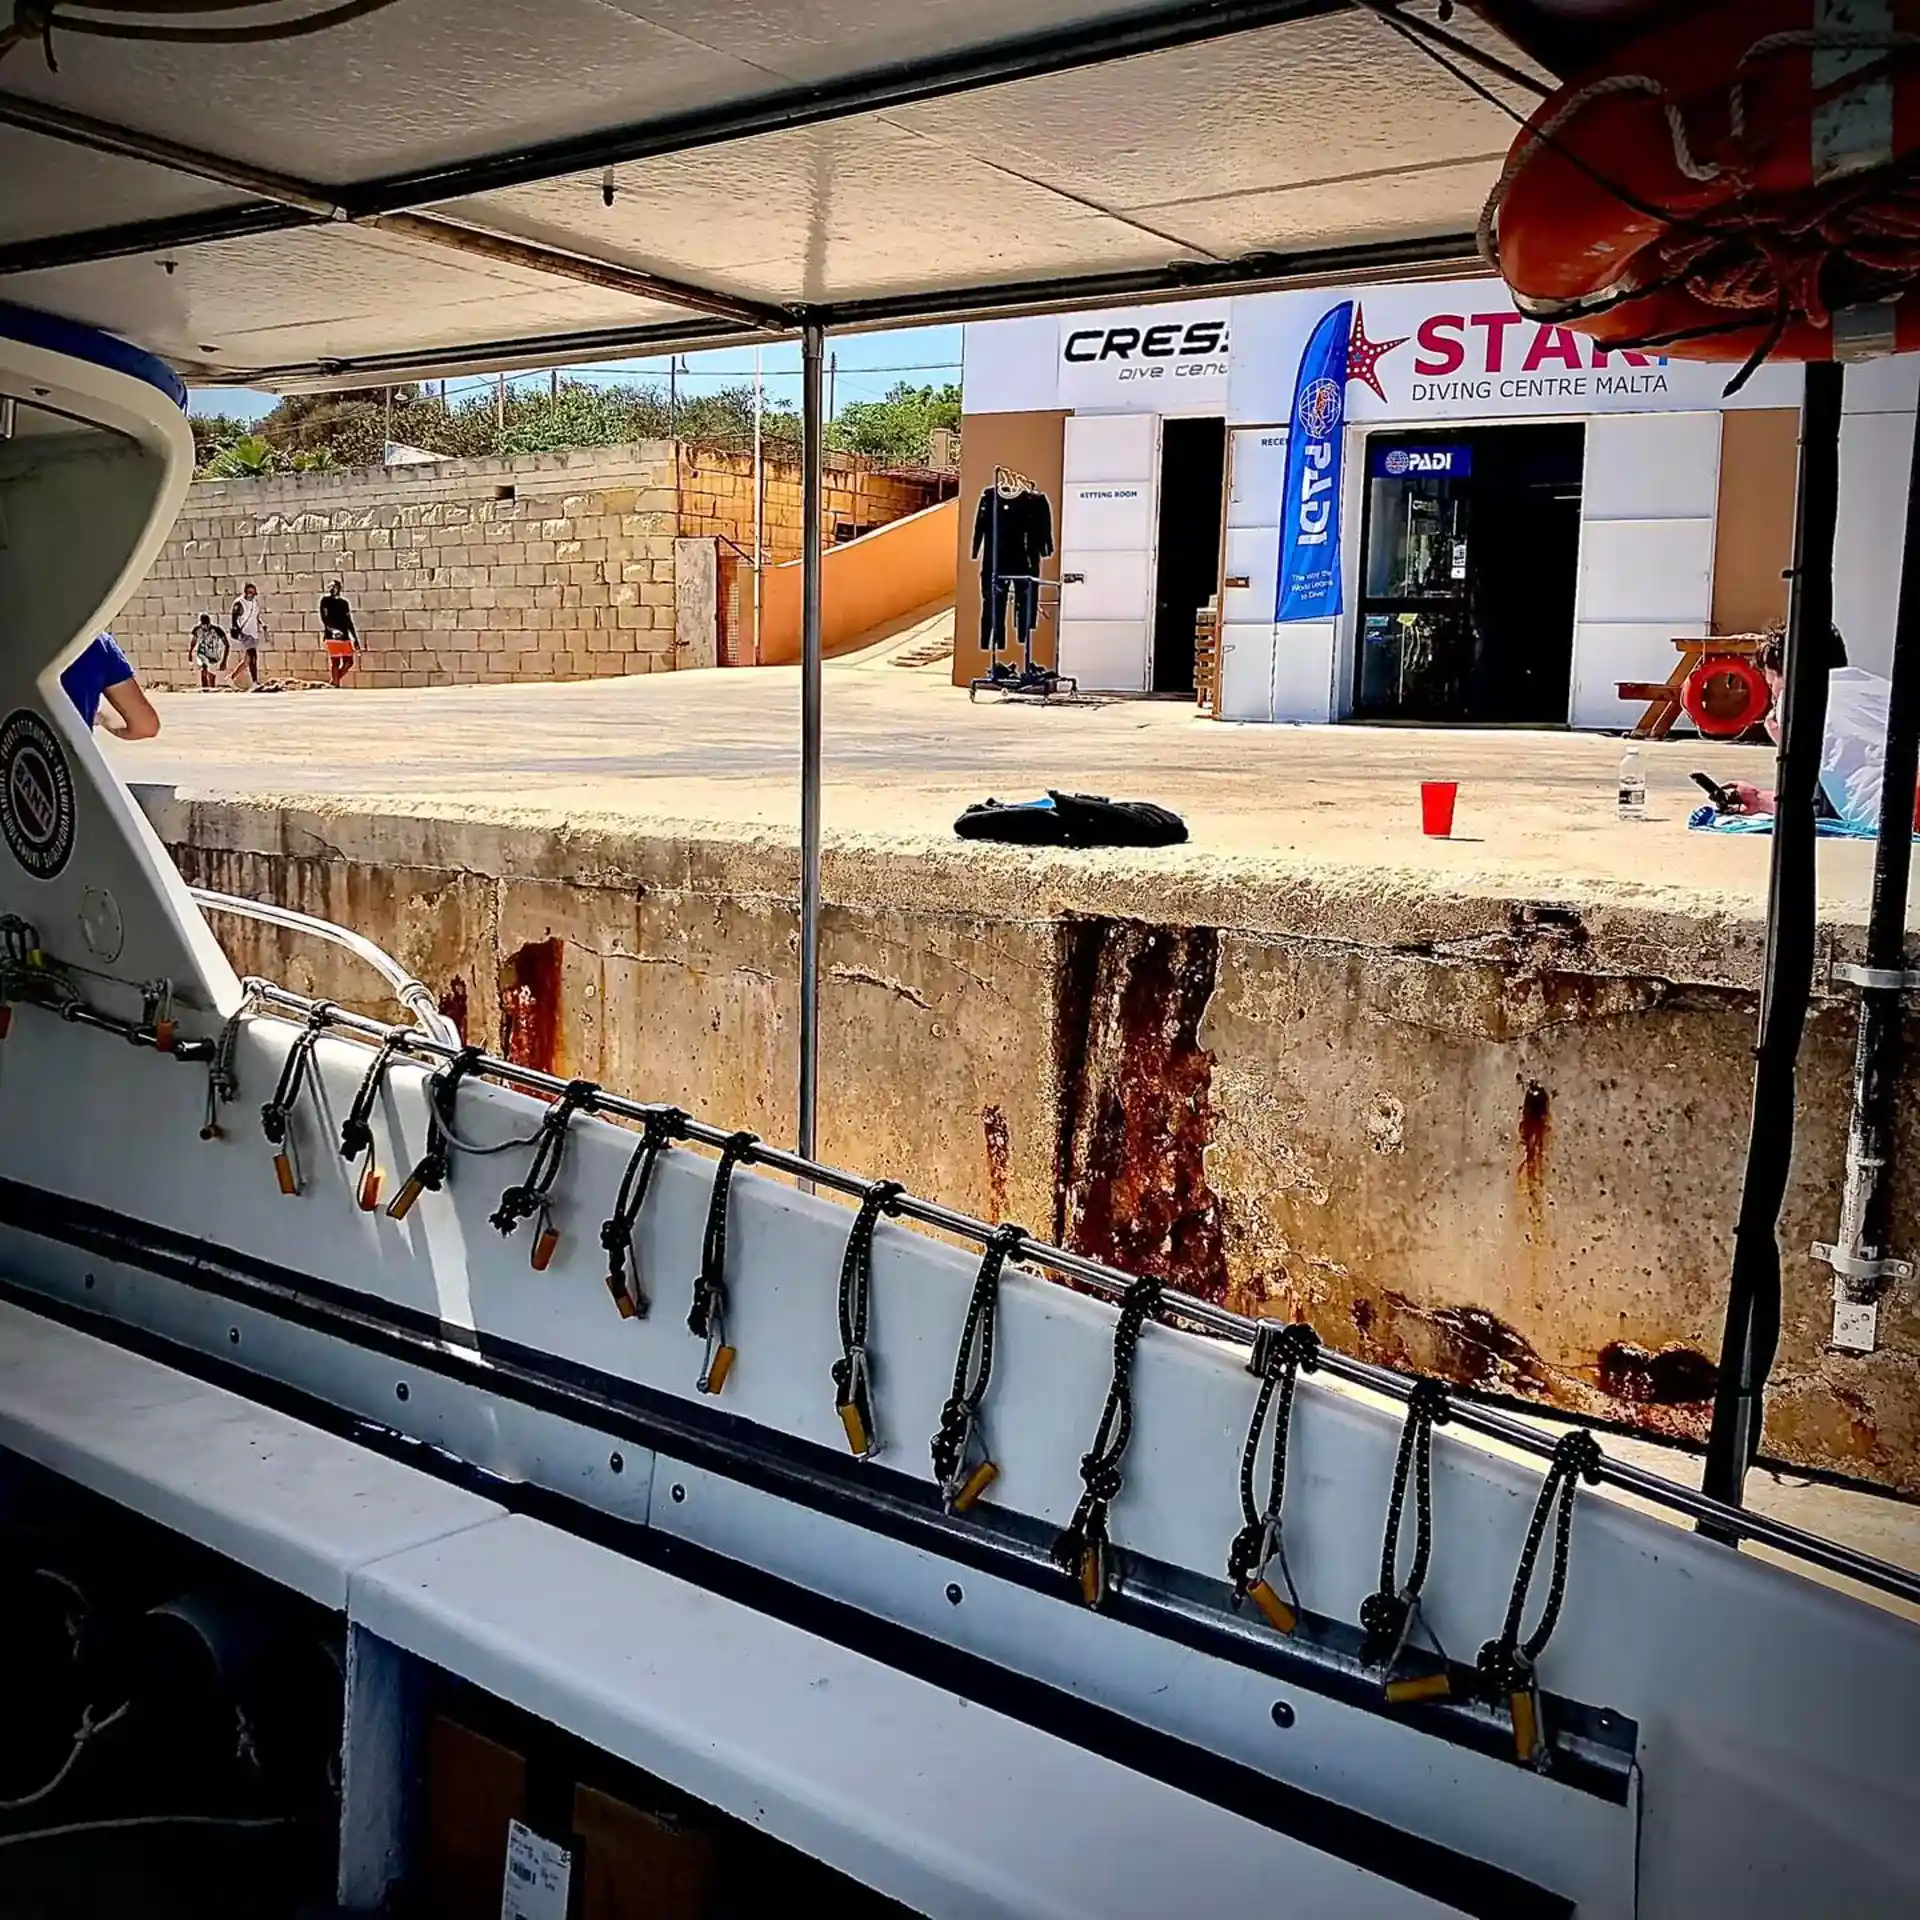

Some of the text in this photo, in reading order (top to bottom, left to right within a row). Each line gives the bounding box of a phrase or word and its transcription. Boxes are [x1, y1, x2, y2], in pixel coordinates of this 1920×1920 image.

[1064, 321, 1229, 362] CRES
[1415, 312, 1668, 375] STA
[1412, 374, 1668, 400] DIVING CENTRE MALTA
[1408, 452, 1453, 471] PADI
[1114, 490, 1137, 498] ROOM
[1298, 442, 1332, 545] PADI
